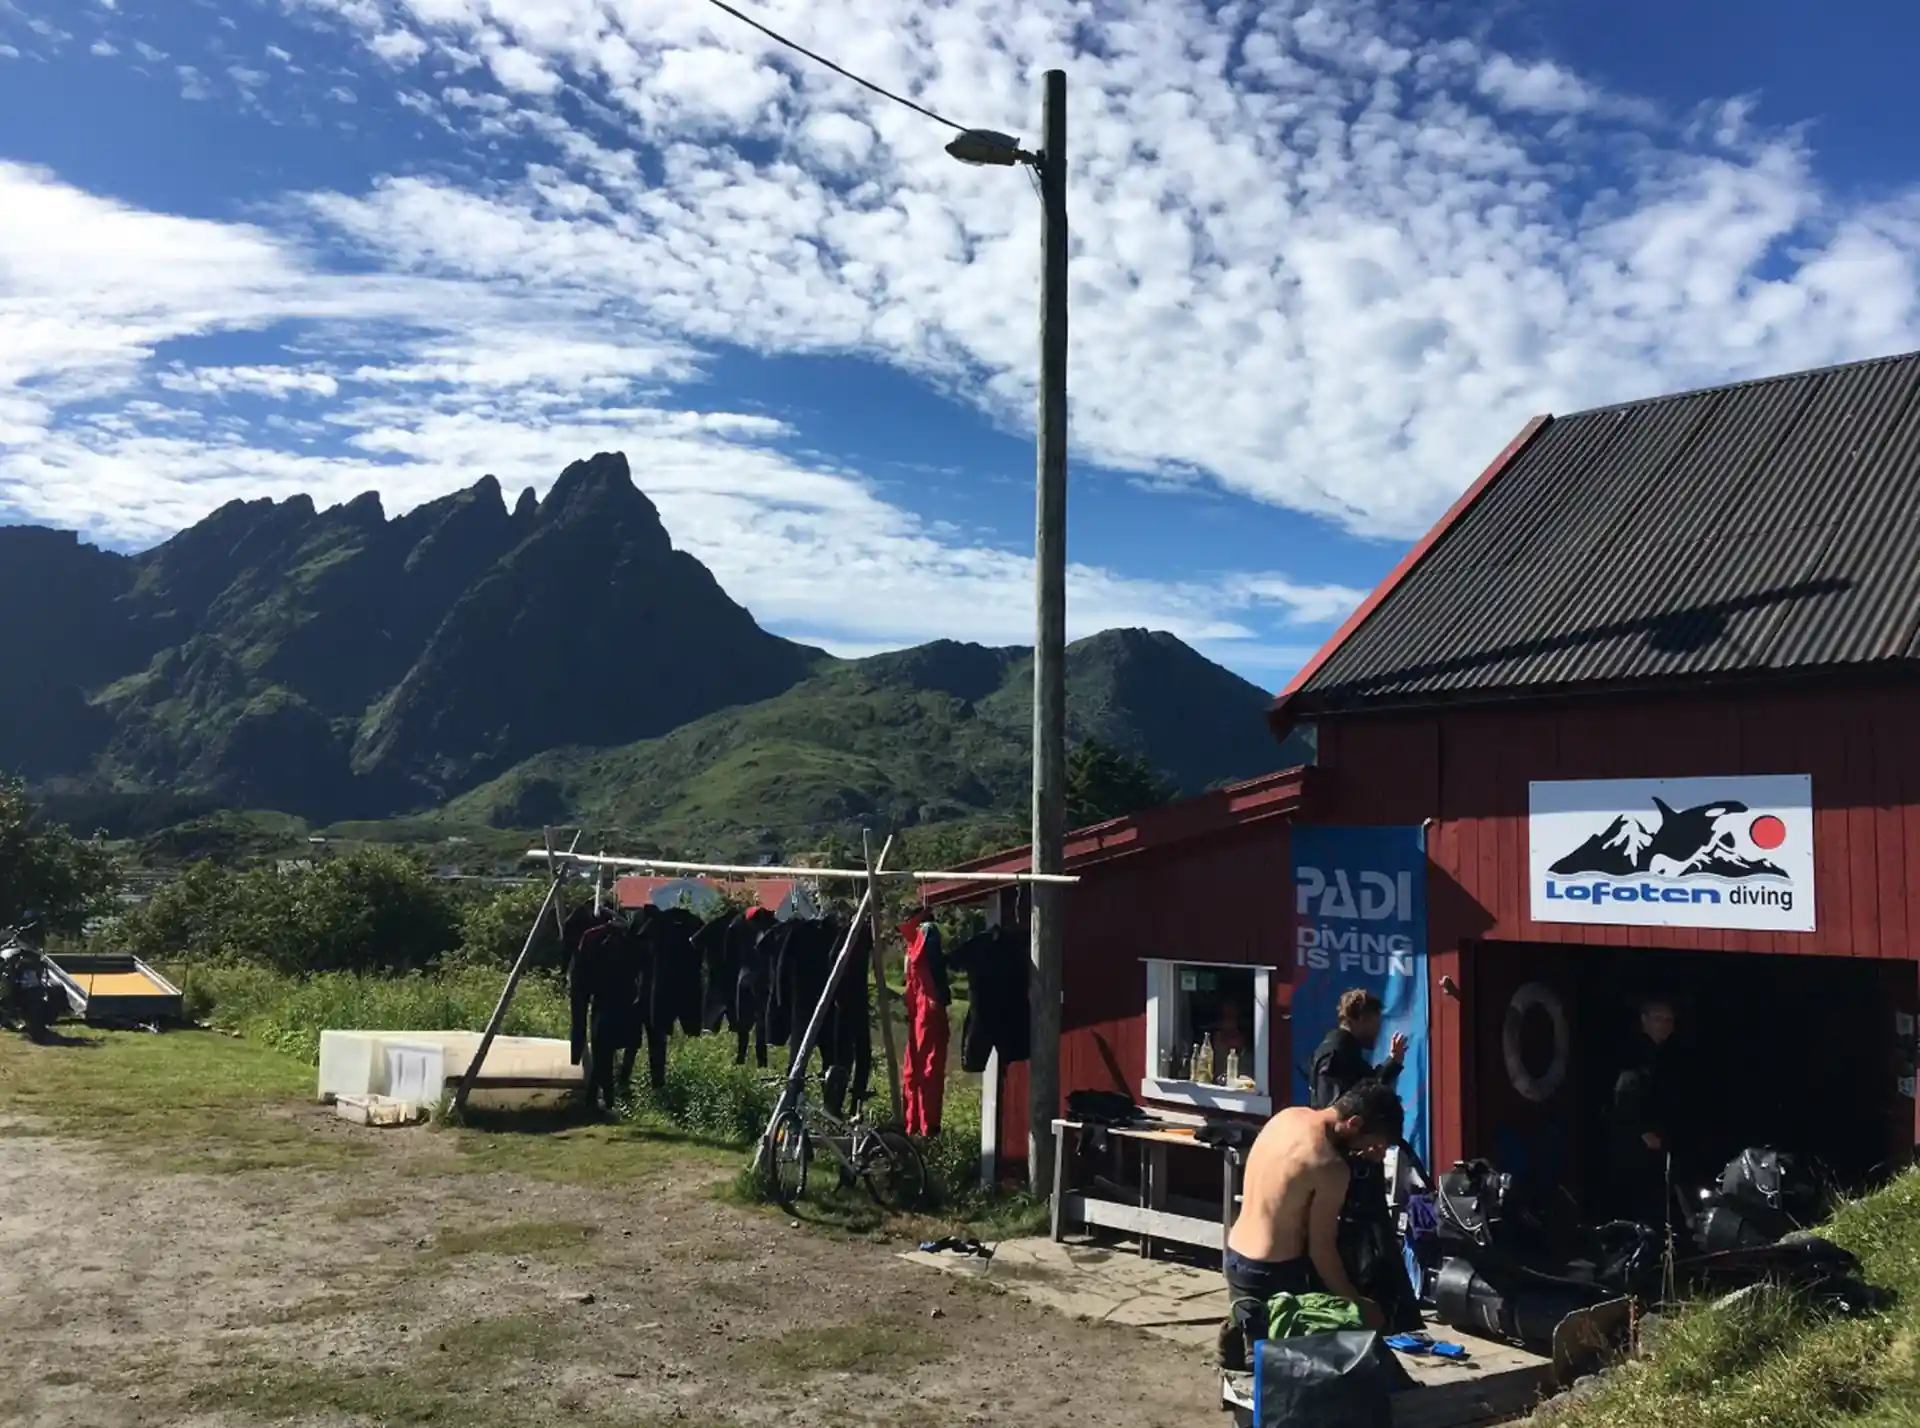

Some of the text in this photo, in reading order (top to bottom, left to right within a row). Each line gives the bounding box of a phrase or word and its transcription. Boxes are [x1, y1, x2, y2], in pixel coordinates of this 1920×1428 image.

[1297, 866, 1411, 921] PADI
[1546, 880, 1793, 911] Lofoten diving
[1340, 952, 1414, 977] FUN
